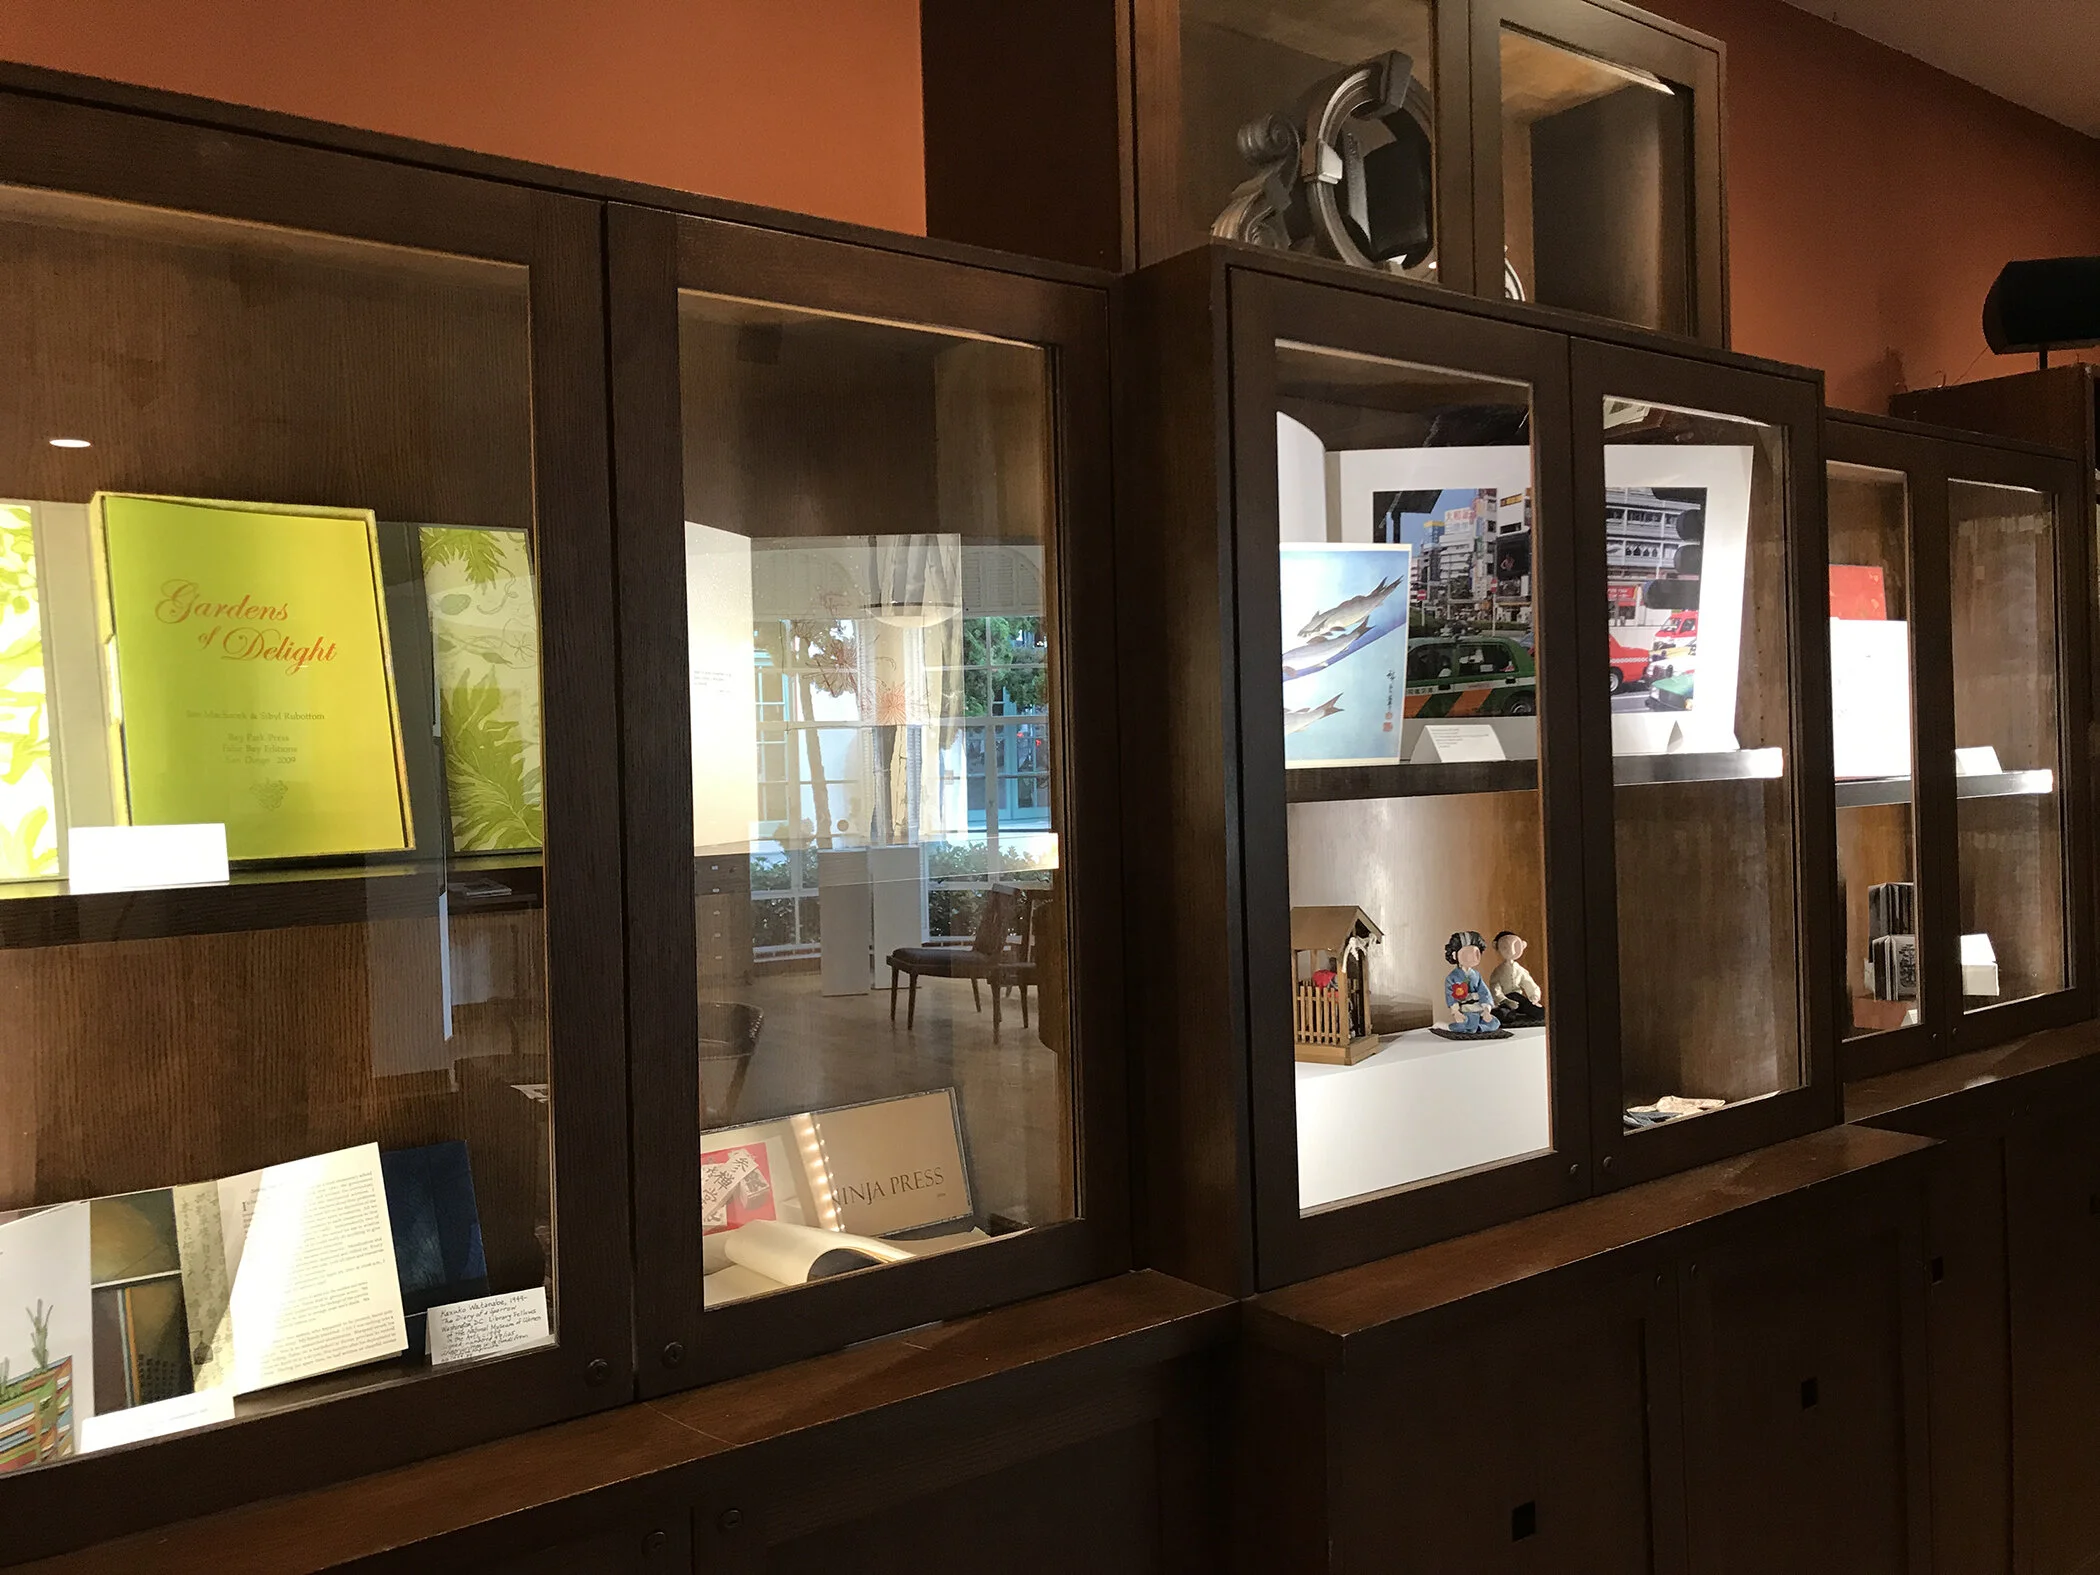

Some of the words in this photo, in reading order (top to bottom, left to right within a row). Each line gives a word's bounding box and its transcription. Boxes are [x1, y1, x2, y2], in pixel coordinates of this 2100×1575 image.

[155, 578, 289, 624] Gardens
[198, 626, 221, 650] of
[221, 627, 337, 675] Delight
[276, 755, 297, 764] 2009
[889, 1166, 945, 1195] PRESS
